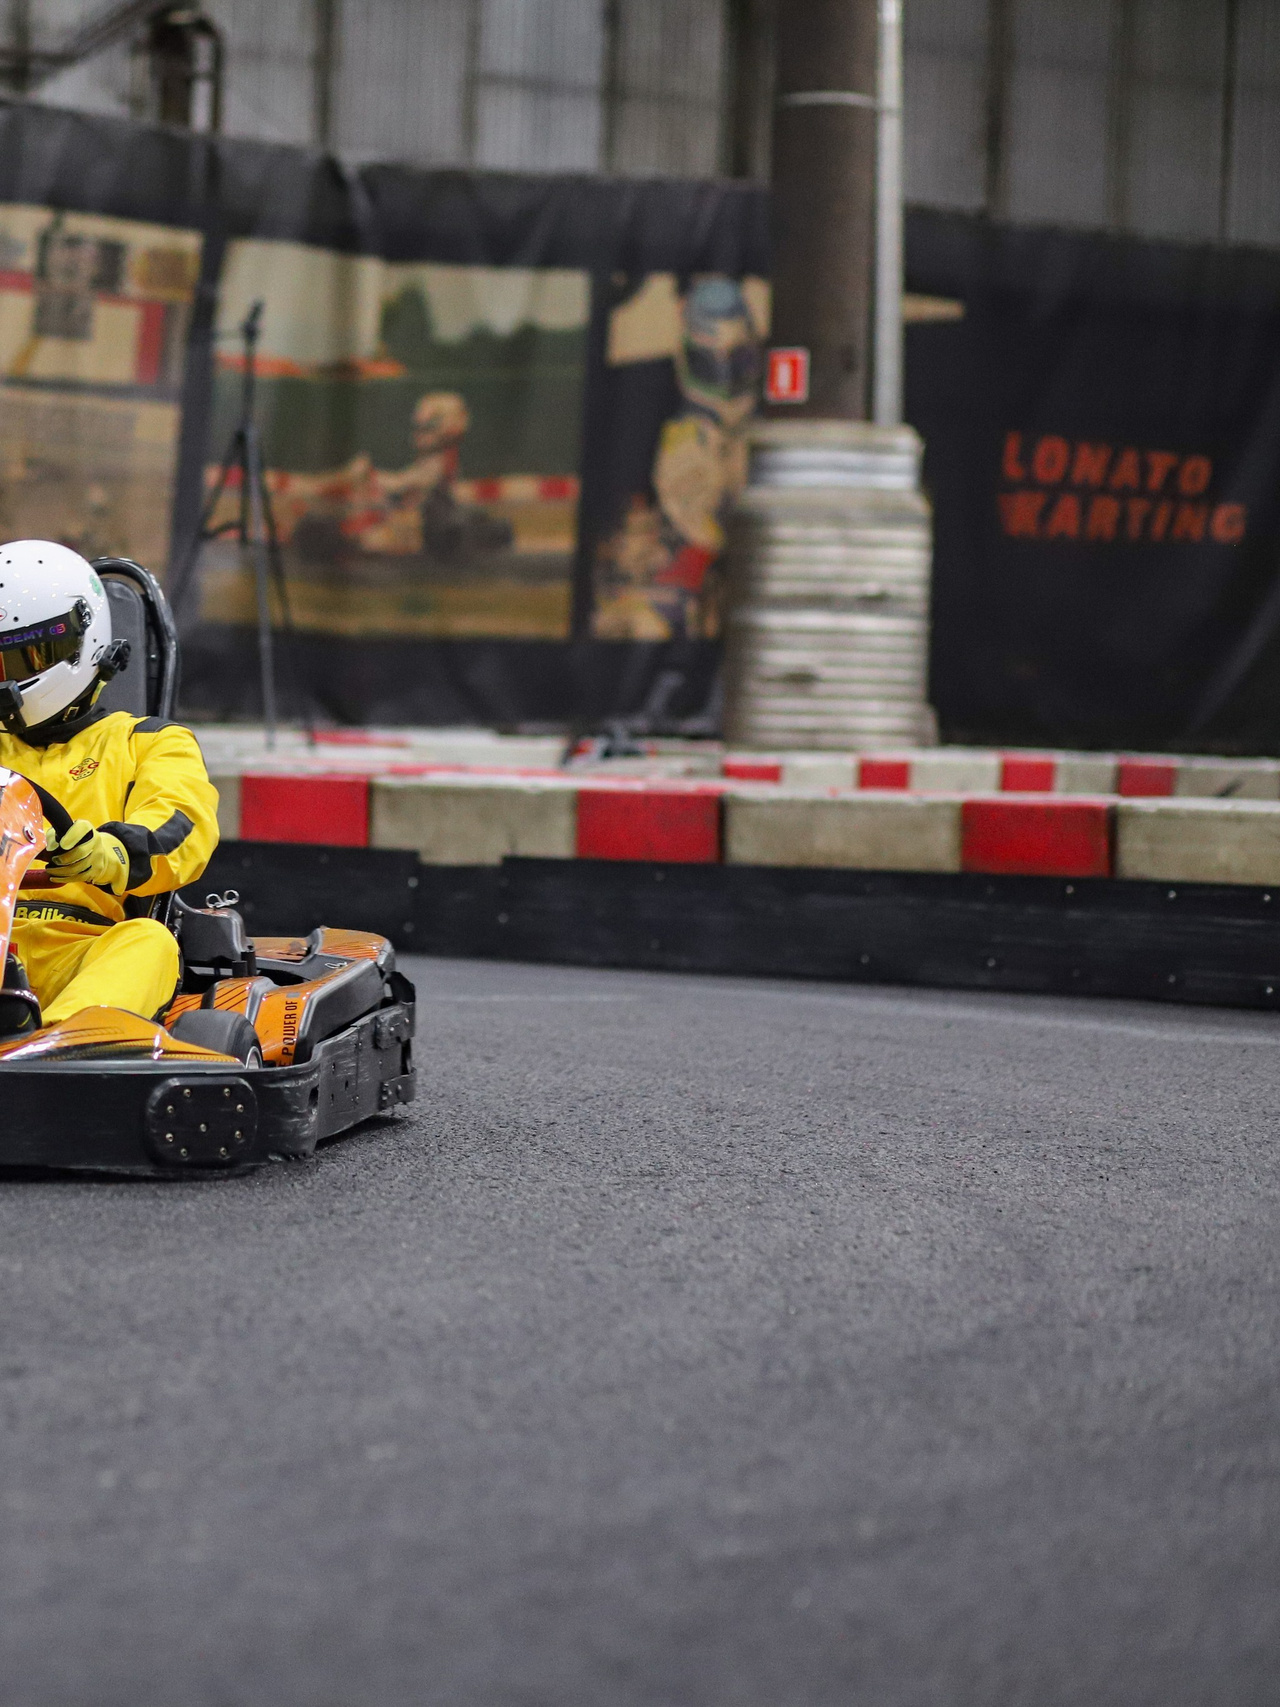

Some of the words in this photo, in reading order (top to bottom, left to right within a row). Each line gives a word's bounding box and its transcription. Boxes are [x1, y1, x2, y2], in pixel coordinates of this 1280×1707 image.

[1002, 430, 1213, 497] LONATO
[999, 490, 1248, 545] KARTING
[15, 906, 90, 924] Beliko
[284, 1000, 299, 1011] OF
[281, 1013, 298, 1057] POWER
